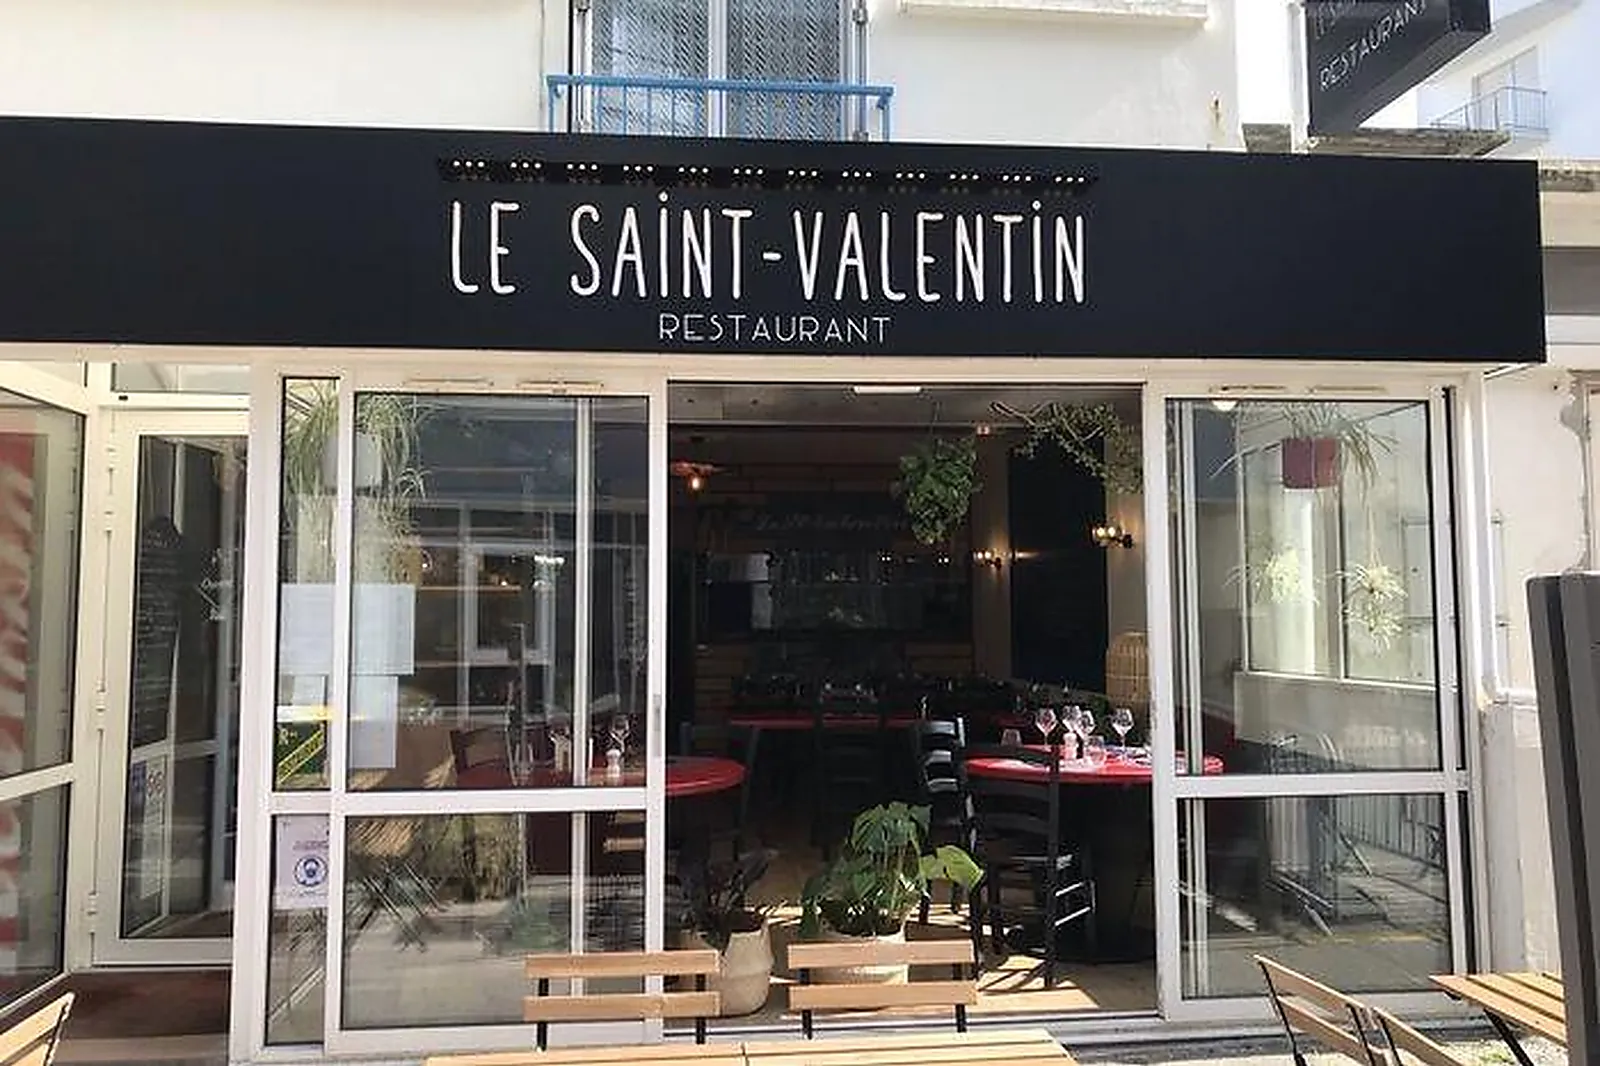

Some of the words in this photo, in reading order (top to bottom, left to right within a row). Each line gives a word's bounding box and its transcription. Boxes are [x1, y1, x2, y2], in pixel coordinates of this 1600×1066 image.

[452, 201, 520, 295] LE
[570, 192, 1085, 304] SAINT-VALENTIN
[659, 313, 891, 344] RESTAURANT
